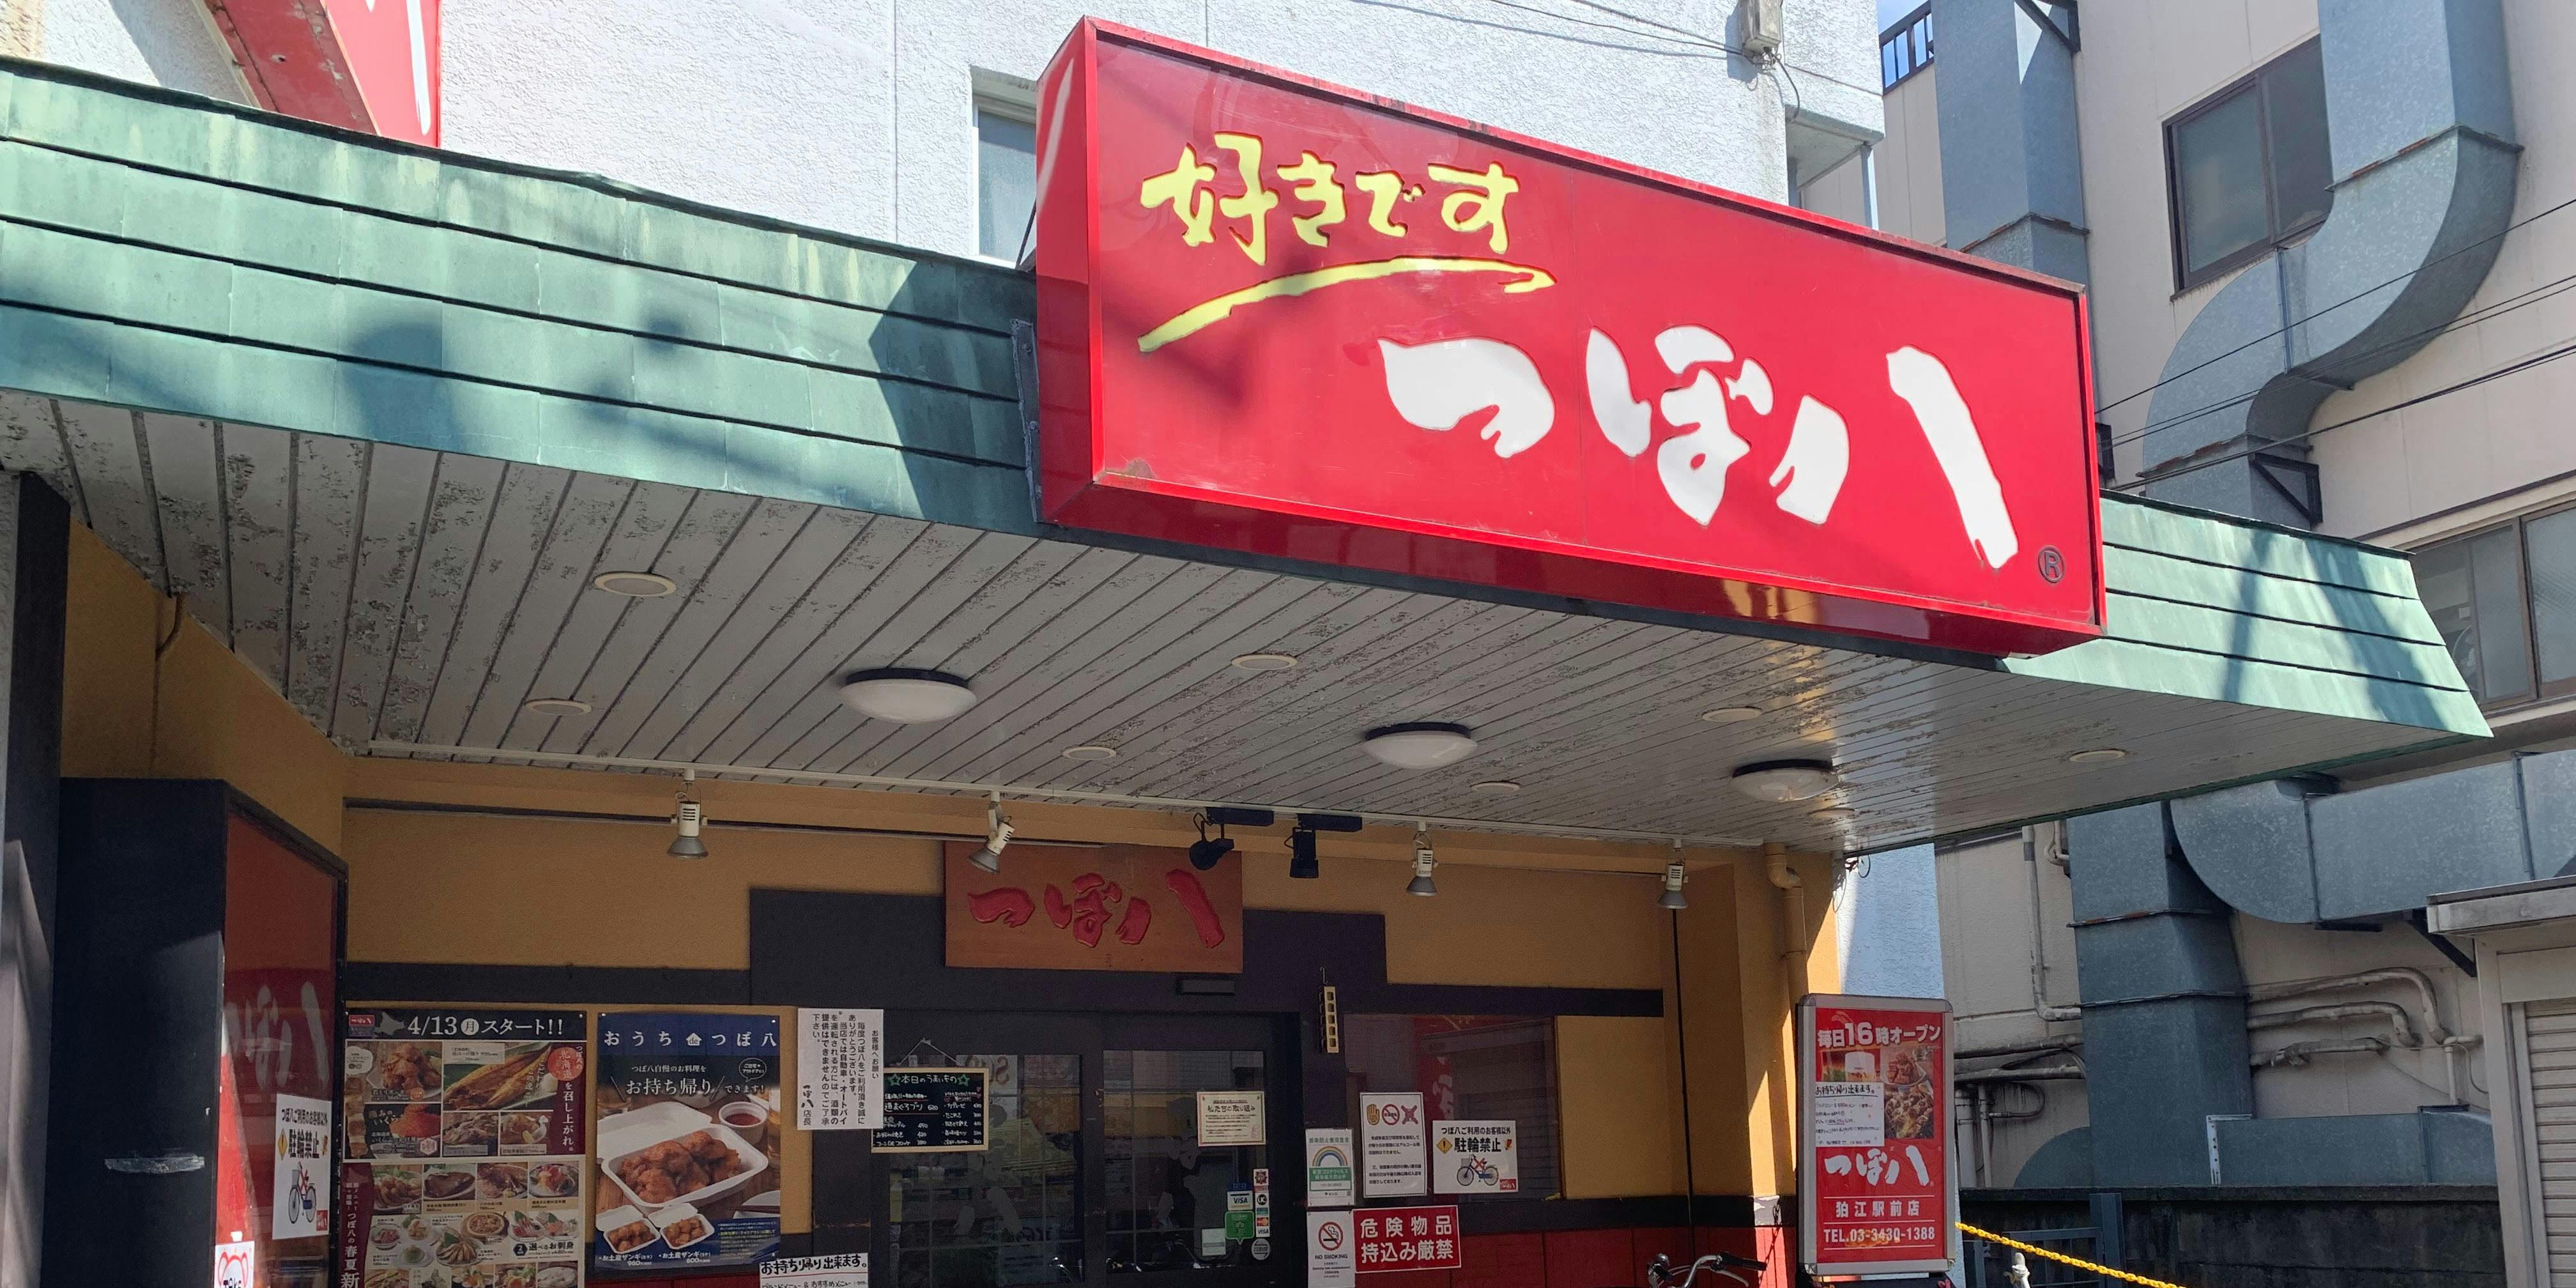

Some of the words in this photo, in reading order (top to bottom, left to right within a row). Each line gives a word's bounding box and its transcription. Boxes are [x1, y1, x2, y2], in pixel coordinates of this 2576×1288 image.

[1140, 131, 1520, 266] 好きです
[1378, 325, 2018, 571] つぼ八
[967, 868, 1225, 949] つぼ八
[408, 1016, 458, 1036] 4/13
[1818, 1022, 1941, 1048] 毎日16時オープン
[848, 1014, 857, 1096] ありがとうございます。
[822, 1013, 830, 1126] 提供はできませんのでご了承
[839, 1022, 848, 1125] 当店では自動車・オートバイ
[901, 1074, 957, 1084] 本日のうまいもの
[626, 1078, 711, 1095] お持ち帰り
[801, 1085, 814, 1108] つぼ八
[803, 1110, 811, 1126] 店長
[1441, 1126, 1510, 1135] つぼ八ご利用のお客様以外
[289, 1128, 320, 1159] 駐輪禁止
[1454, 1137, 1501, 1153] 駐輪禁止
[1824, 1144, 1930, 1186] つぼ八
[1836, 1200, 1920, 1218] 狛江駅前店
[1360, 1215, 1452, 1239] 危険物品
[1823, 1226, 1936, 1243] TEL.03-3430-1388
[1361, 1239, 1453, 1264] 持込み厳禁
[761, 1254, 867, 1275] お持ち帰り出来ます。
